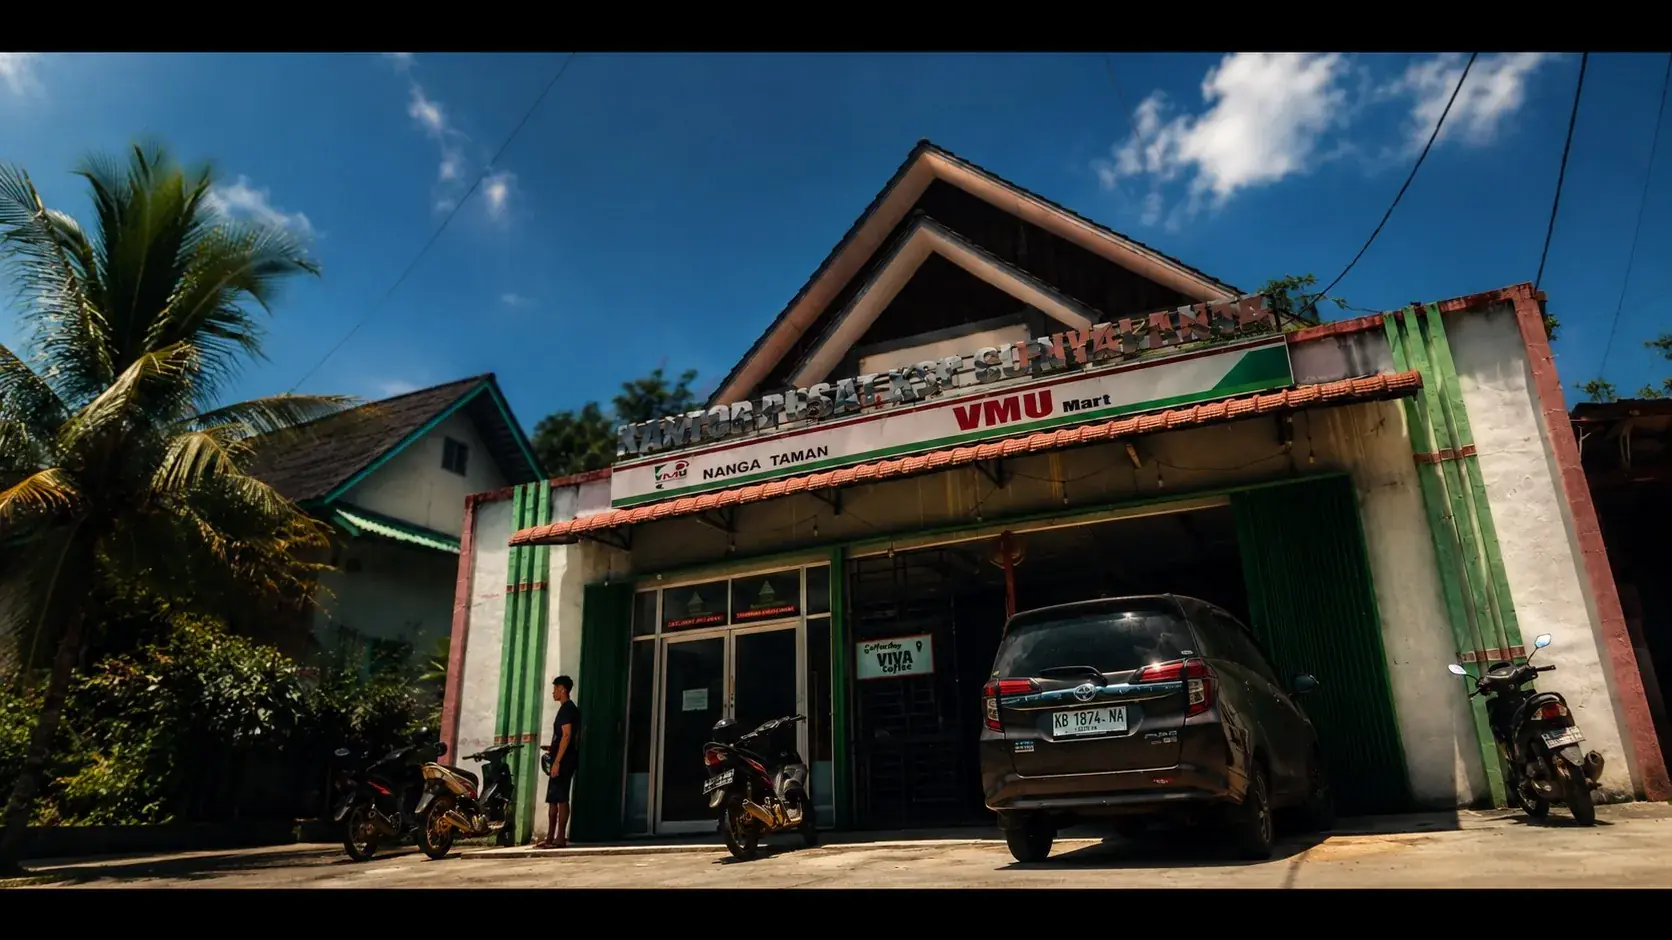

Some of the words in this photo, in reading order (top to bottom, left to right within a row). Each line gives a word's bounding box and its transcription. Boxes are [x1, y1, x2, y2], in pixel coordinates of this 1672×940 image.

[952, 389, 1053, 431] VMU
[1062, 393, 1111, 413] Mart
[703, 459, 761, 480] NANGA
[770, 446, 828, 467] TAMAN
[876, 649, 914, 667] VIVA
[1054, 713, 1069, 728] KB
[1073, 710, 1101, 726] 1874
[1109, 707, 1124, 723] NA
